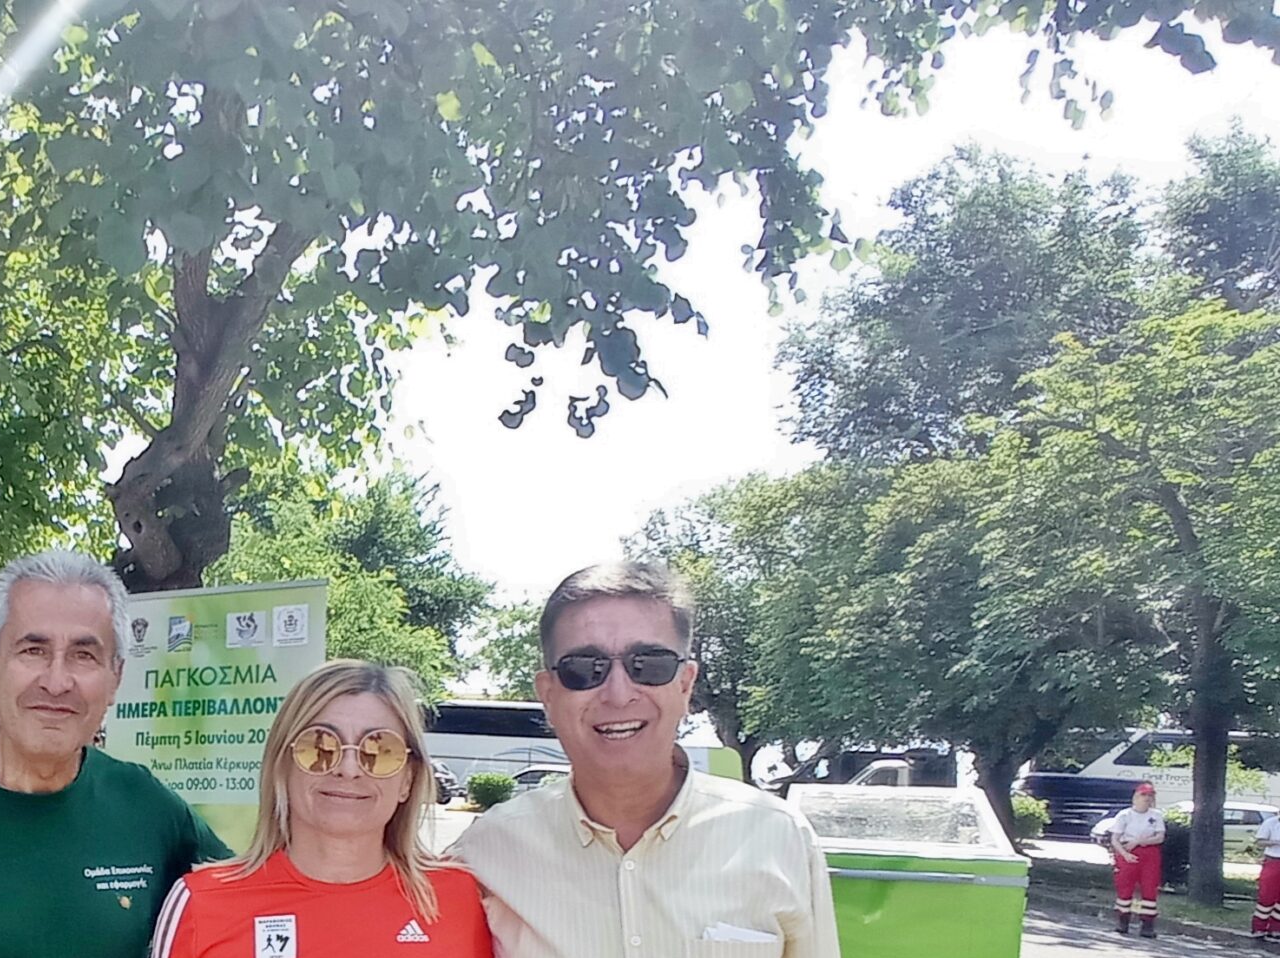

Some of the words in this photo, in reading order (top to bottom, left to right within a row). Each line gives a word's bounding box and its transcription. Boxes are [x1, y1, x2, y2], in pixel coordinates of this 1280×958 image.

[144, 664, 277, 689] ΠΑΓΚΟΣΜΙΑ
[116, 701, 168, 719] ΗΜΕΡΑ
[135, 731, 181, 750] Πέμπτη
[183, 730, 193, 745] 5
[195, 729, 245, 745] Ιουνίου
[248, 728, 270, 744] 20
[150, 758, 173, 771] Άνω
[175, 757, 213, 771] Πλατεία
[186, 777, 217, 791] 09:00
[225, 777, 255, 791] 13:00
